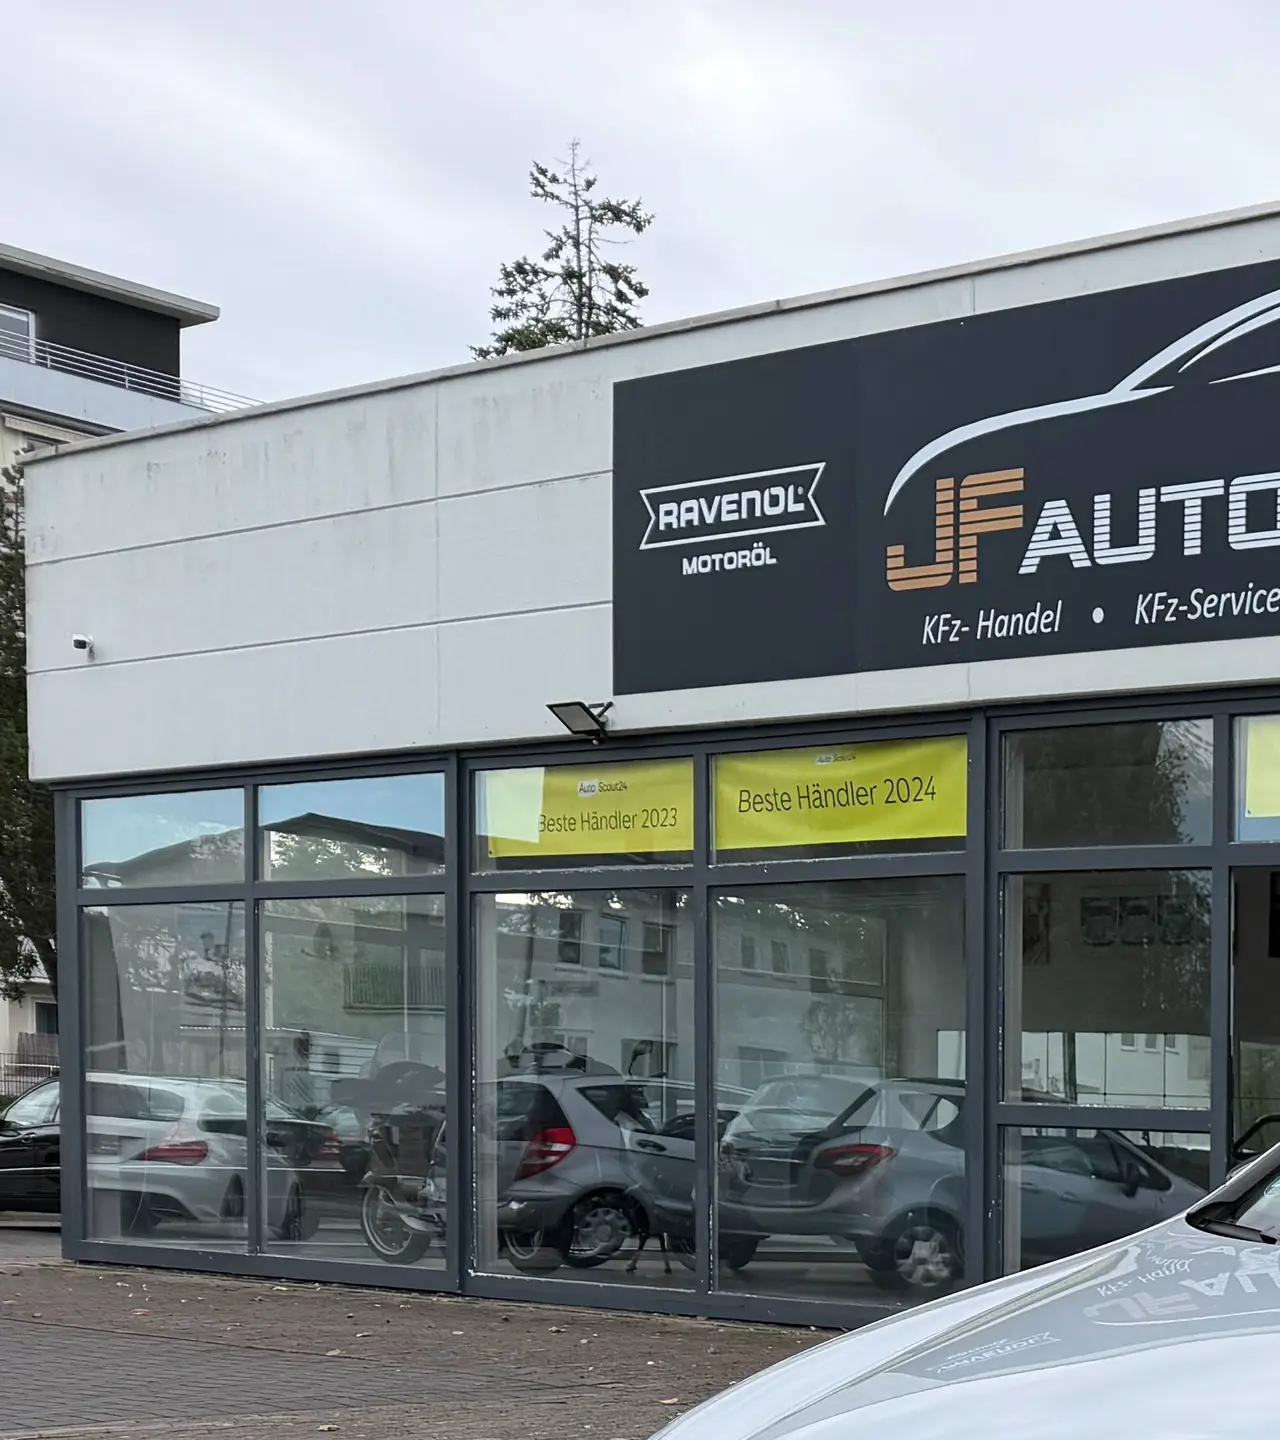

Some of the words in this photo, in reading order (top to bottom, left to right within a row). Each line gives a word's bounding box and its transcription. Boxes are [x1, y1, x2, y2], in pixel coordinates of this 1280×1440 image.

[658, 485, 805, 530] RAVENOL
[886, 467, 1024, 591] JF
[682, 541, 777, 575] MOTORÖL
[976, 600, 1062, 640] Handel
[738, 787, 792, 813] Beste
[797, 780, 878, 810] Händler
[883, 775, 937, 805] 2024
[539, 813, 577, 833] Beste
[580, 809, 638, 831] Händler
[641, 807, 678, 828] 2023
